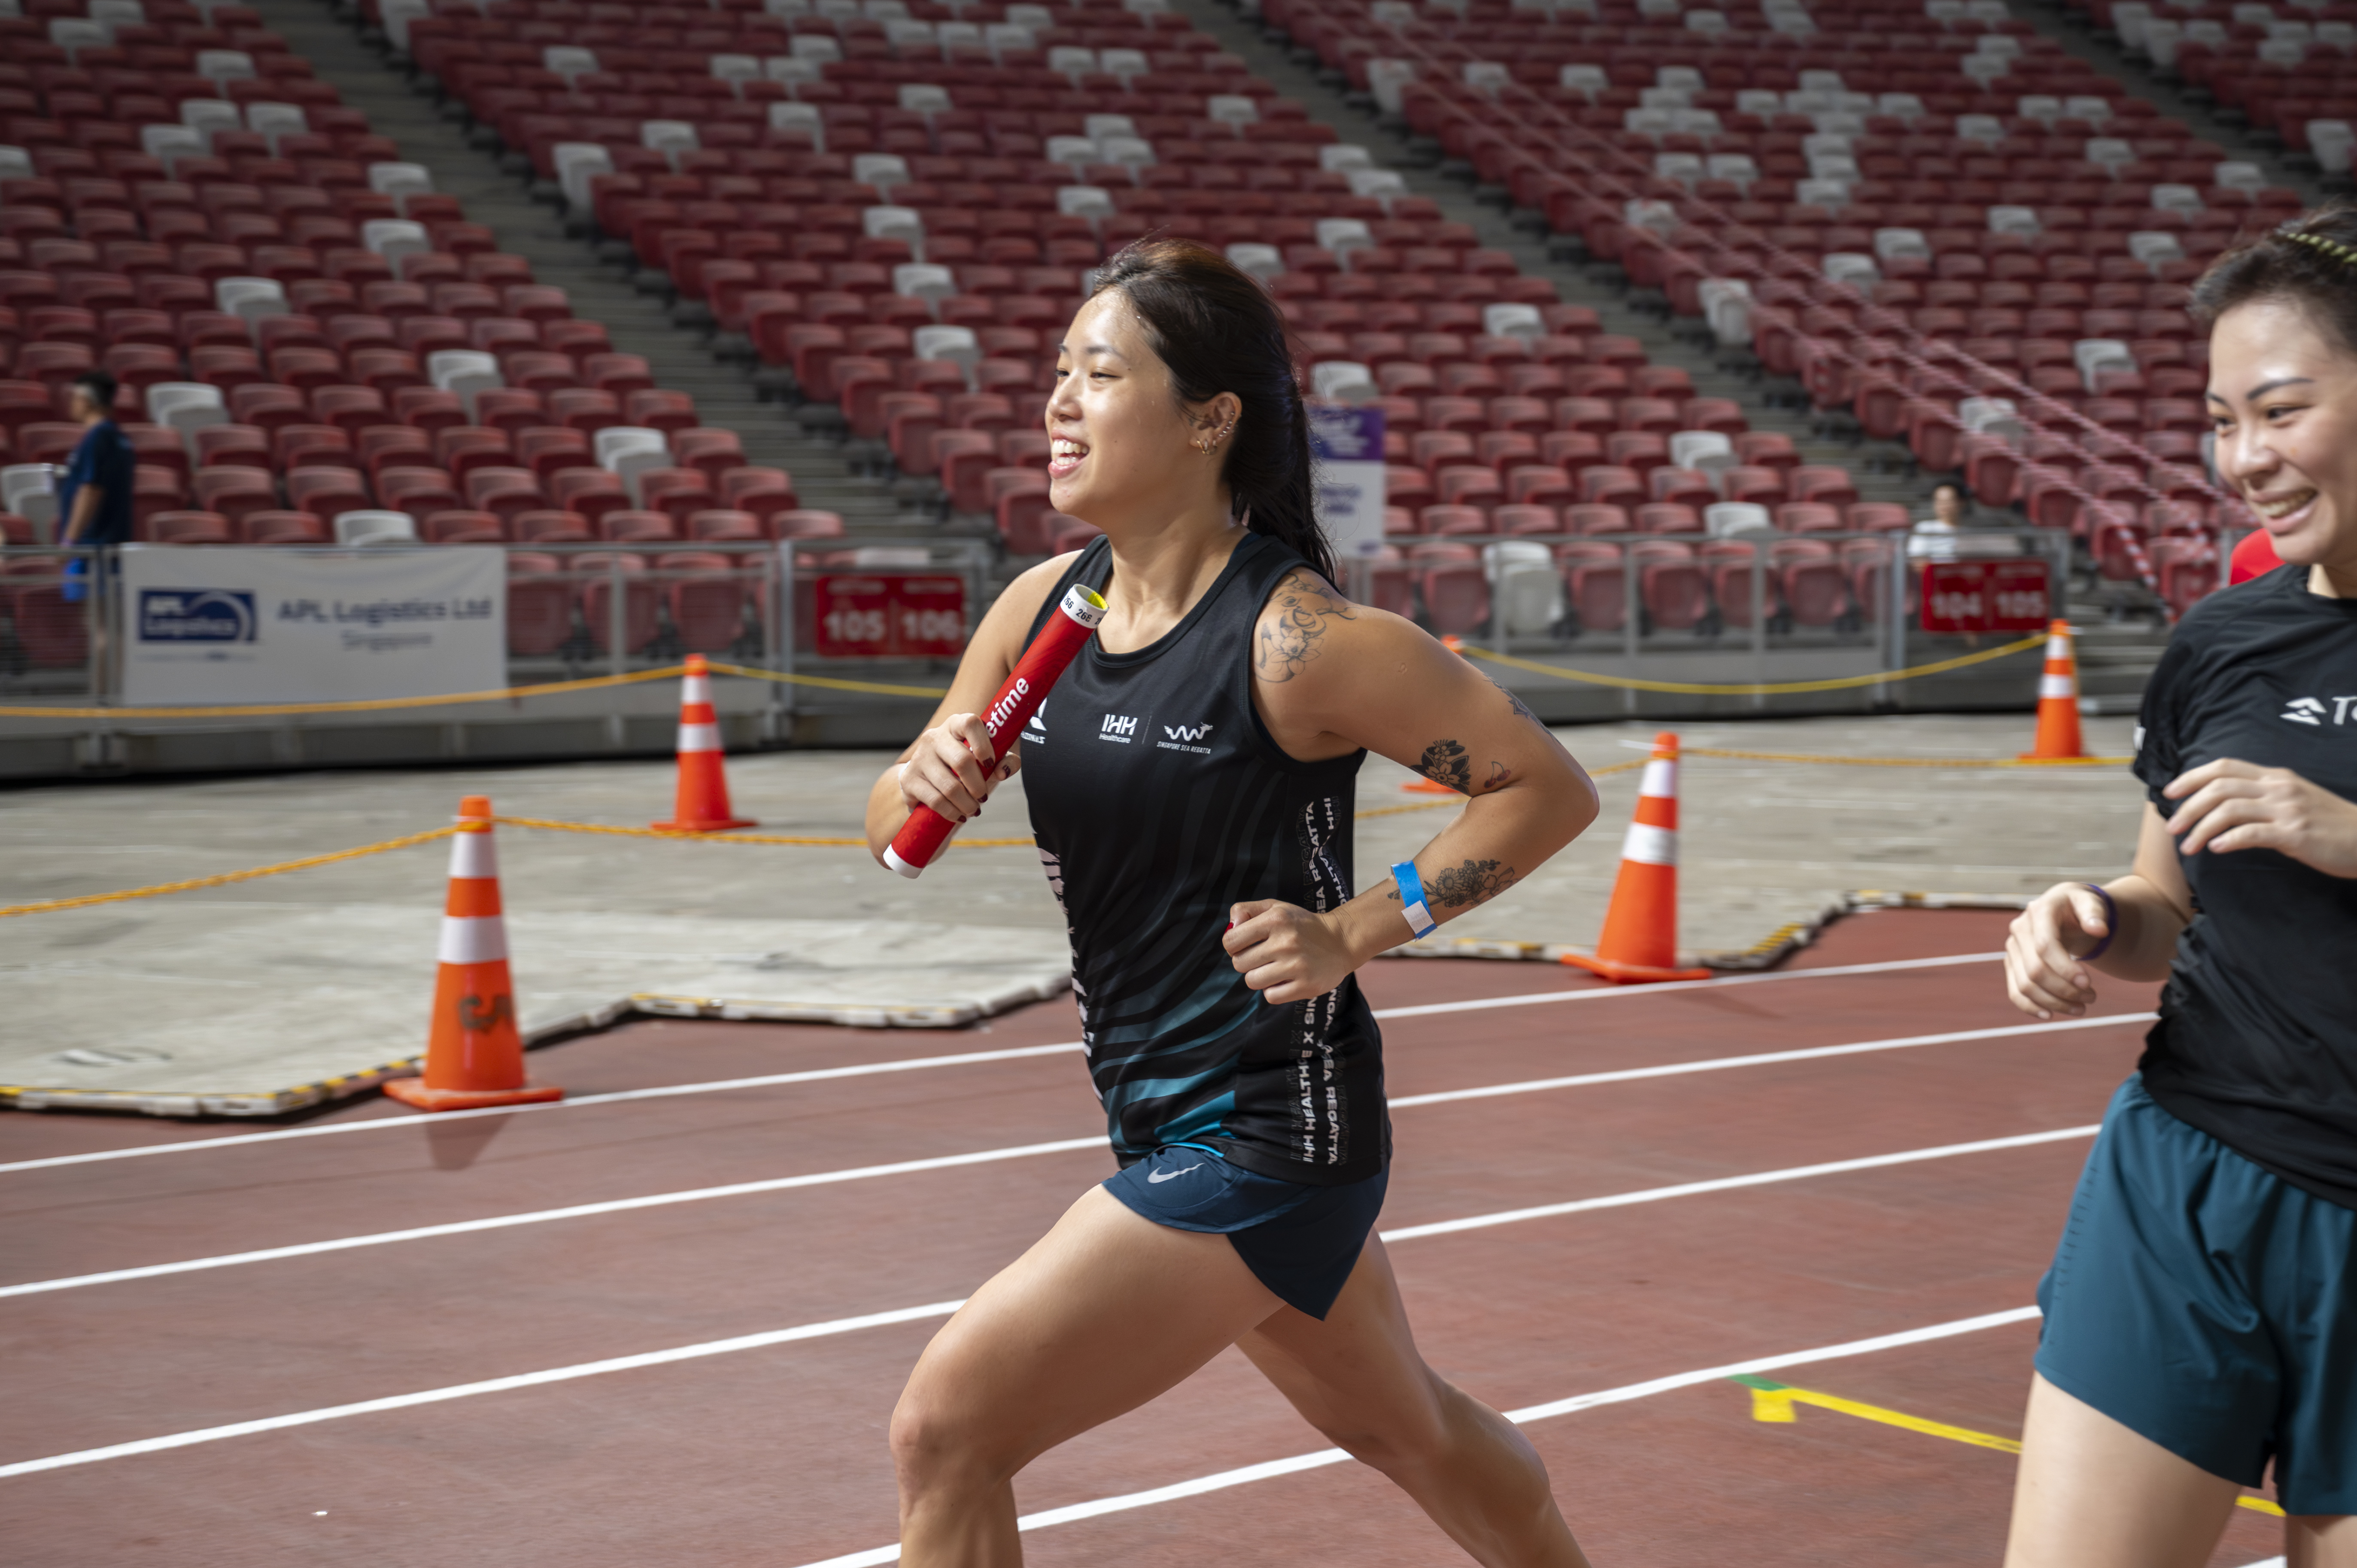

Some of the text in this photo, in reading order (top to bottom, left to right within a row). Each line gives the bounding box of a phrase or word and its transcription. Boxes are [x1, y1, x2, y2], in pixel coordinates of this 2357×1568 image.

[277, 599, 330, 622] APL
[335, 597, 446, 627] Logistics
[823, 610, 886, 641] 105
[904, 610, 960, 641] 106
[986, 678, 1029, 738] etime
[1099, 733, 1131, 743] Healthcare
[1157, 741, 1181, 750] SINGAPORE
[1303, 1031, 1314, 1044] X
[1325, 1086, 1340, 1165] REGATTA
[1303, 1134, 1316, 1162] IHH
